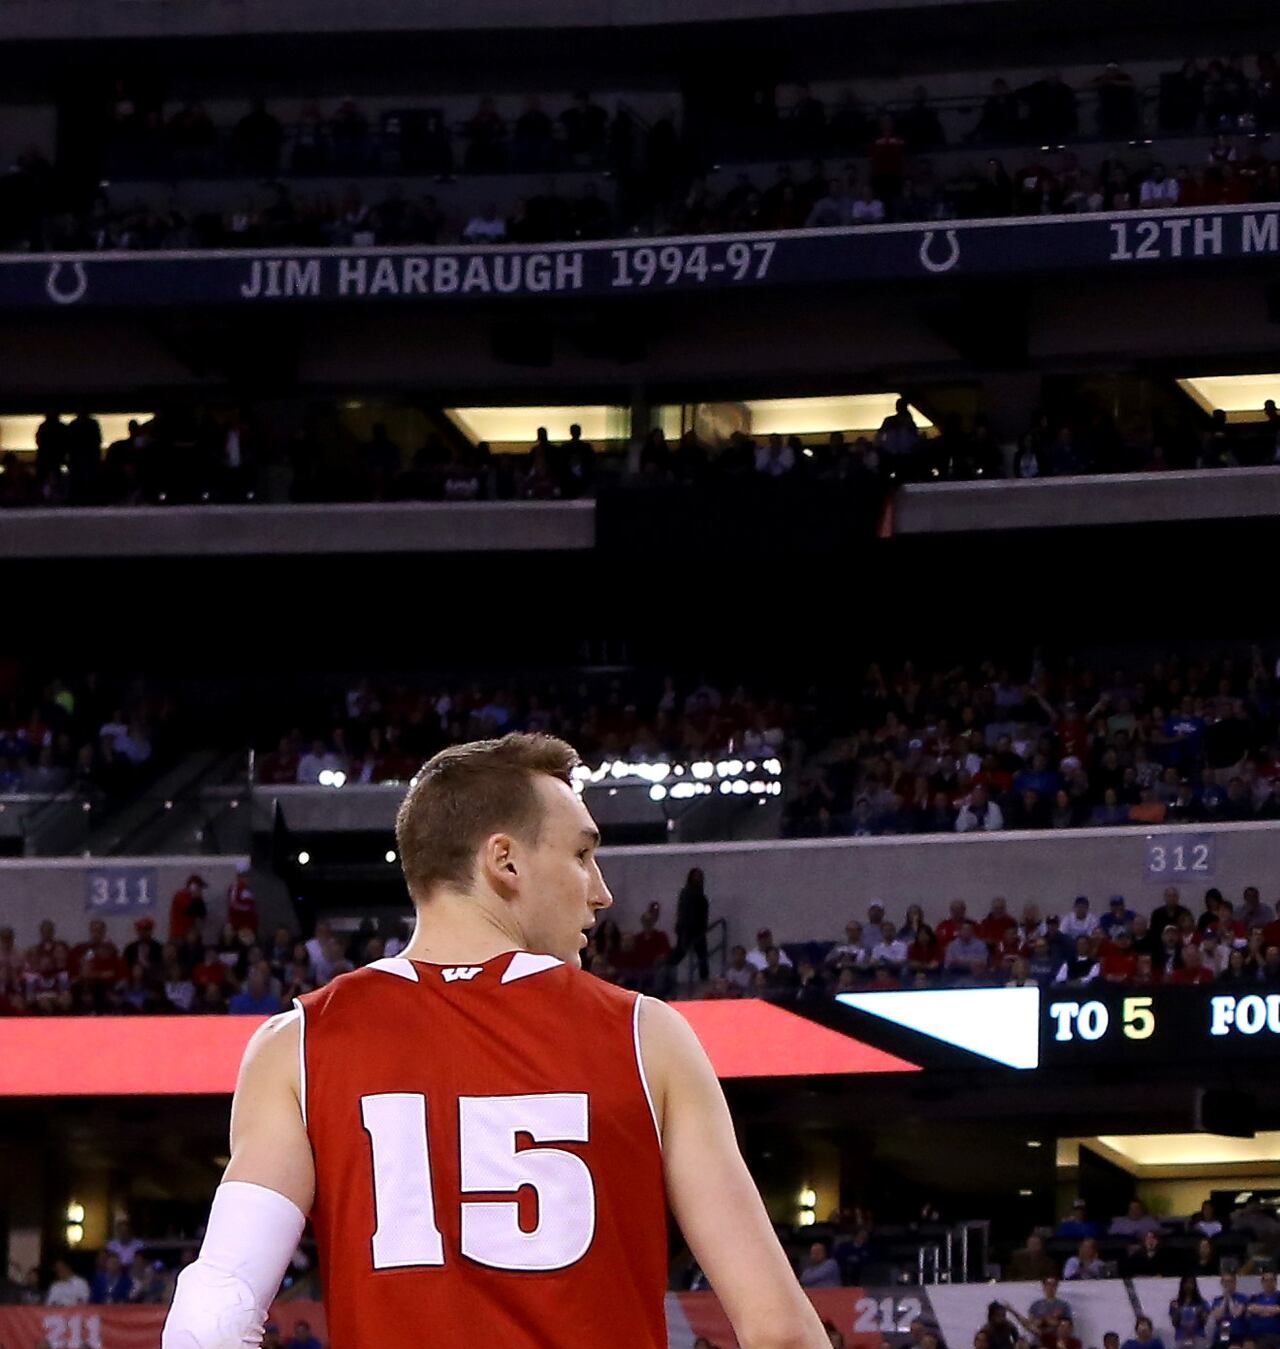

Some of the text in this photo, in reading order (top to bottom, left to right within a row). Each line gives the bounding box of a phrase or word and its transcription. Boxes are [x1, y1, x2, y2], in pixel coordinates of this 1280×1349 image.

[1109, 216, 1223, 261] 12TH
[240, 241, 777, 298] JIM HARBAUGH 1994-97
[1150, 845, 1209, 872] 312
[91, 878, 151, 905] 311
[1050, 1001, 1109, 1041] TO
[1123, 997, 1155, 1039] 5
[361, 1092, 595, 1270] 15
[853, 1297, 921, 1333] 212
